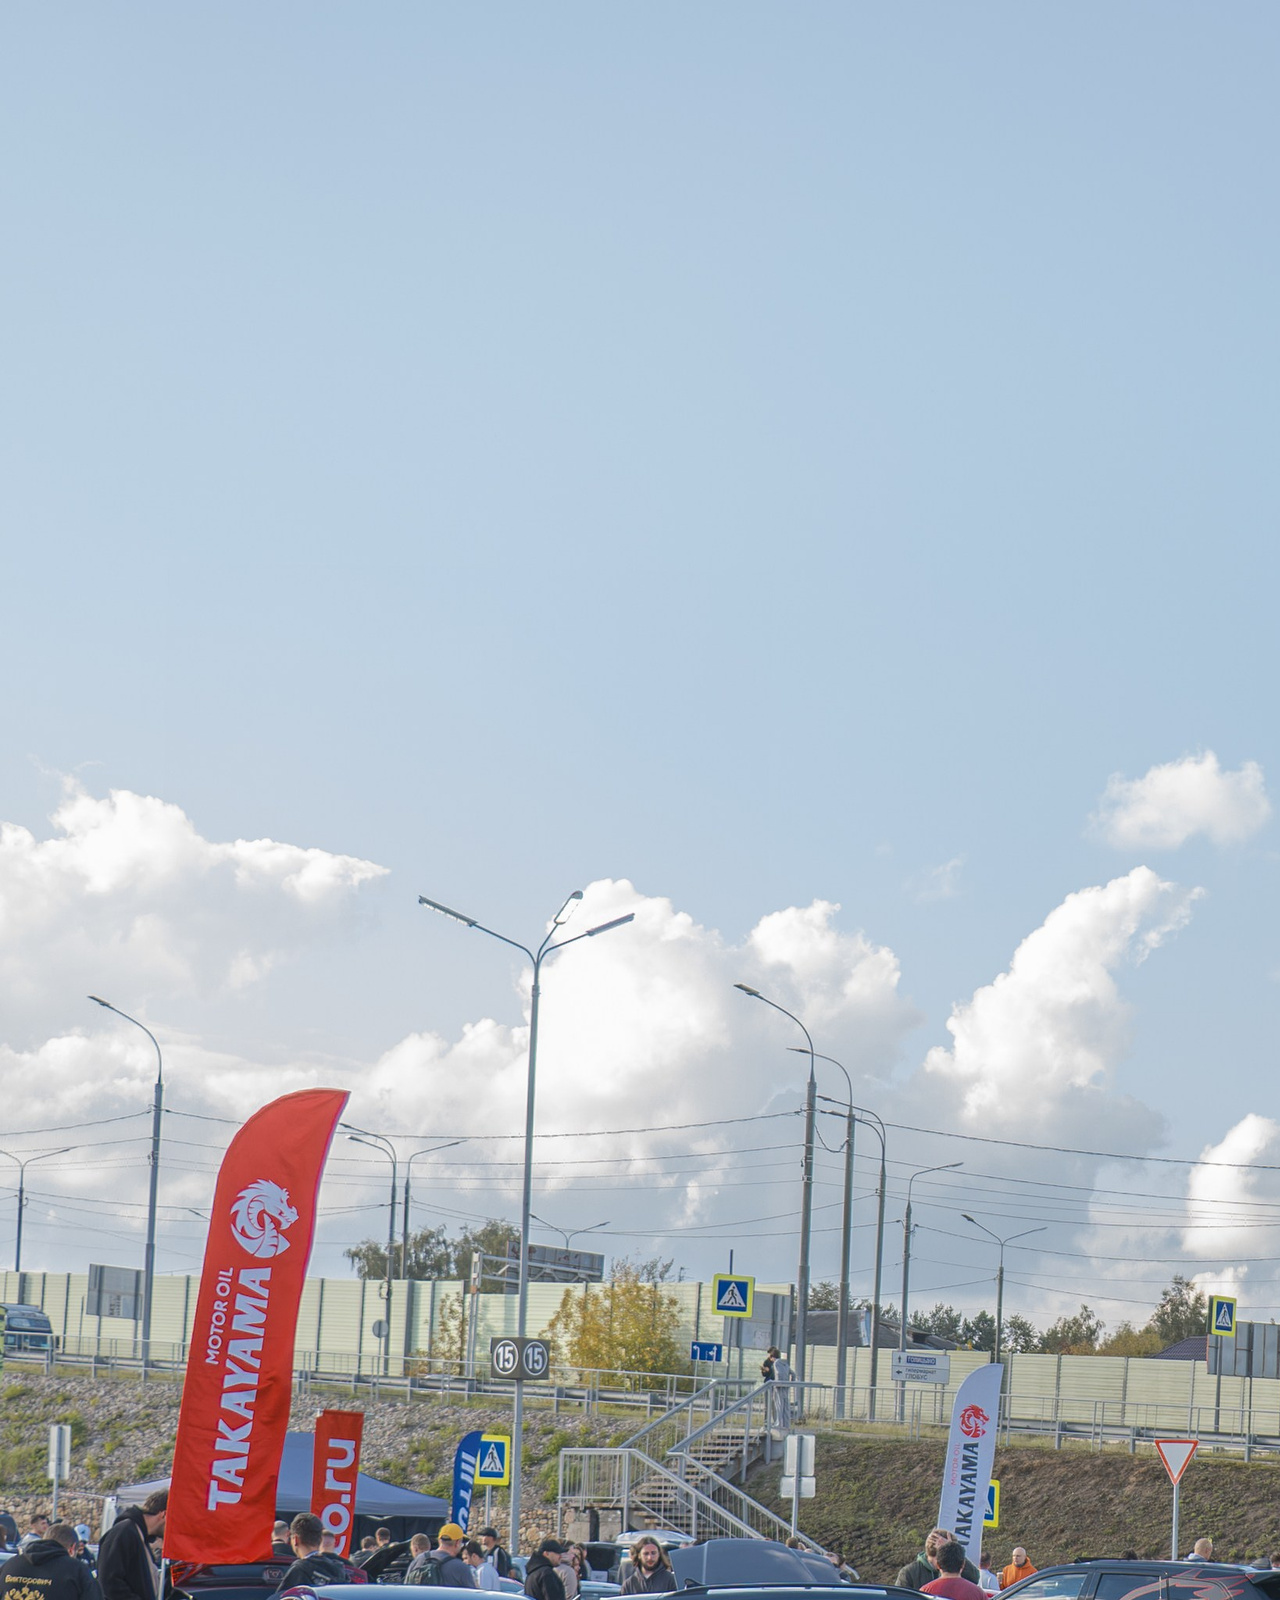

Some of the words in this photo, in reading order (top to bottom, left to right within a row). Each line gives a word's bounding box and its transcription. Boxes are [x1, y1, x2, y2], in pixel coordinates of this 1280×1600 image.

[216, 1266, 234, 1297] OIL
[205, 1299, 229, 1366] MOTOR
[497, 1345, 514, 1370] 15
[527, 1346, 543, 1370] 15
[207, 1265, 273, 1512] TAKAYAMA
